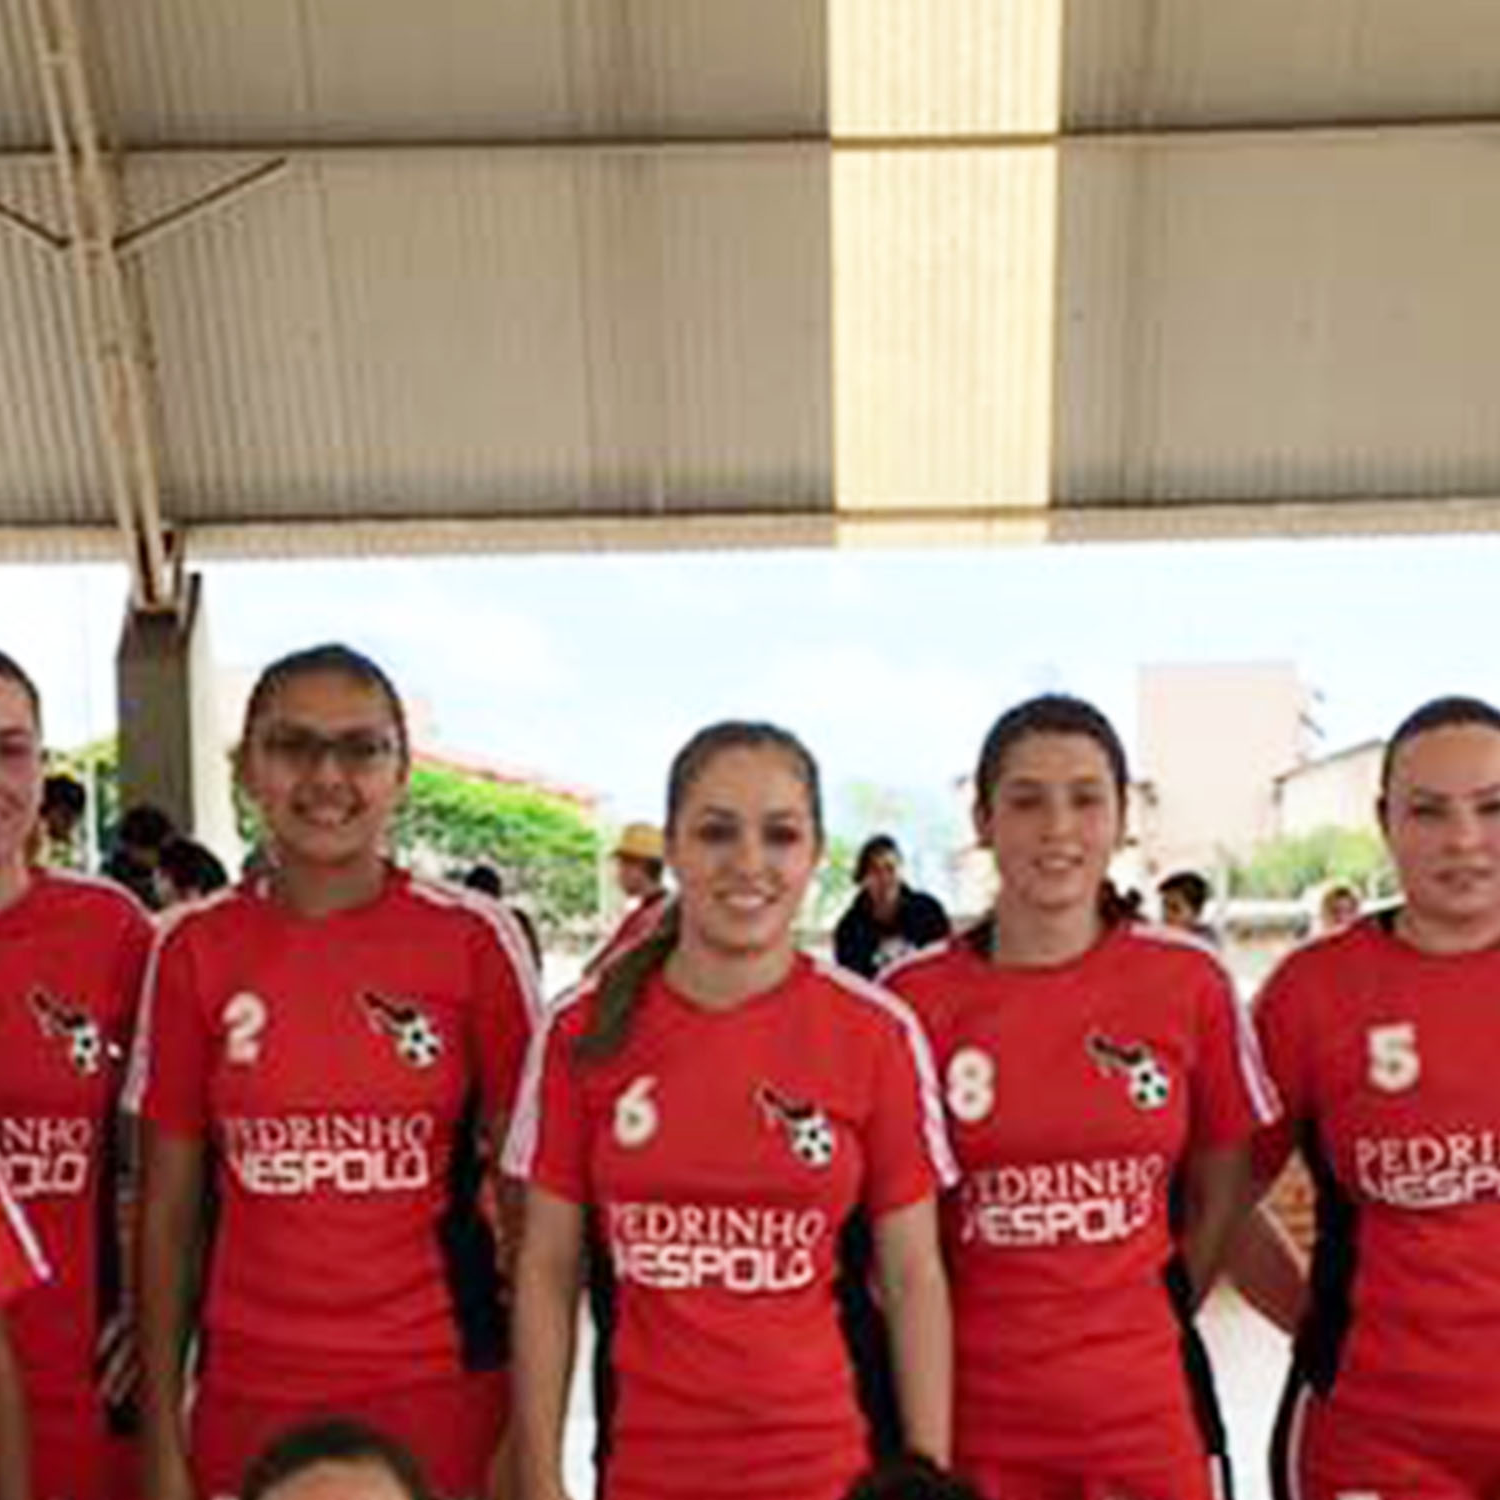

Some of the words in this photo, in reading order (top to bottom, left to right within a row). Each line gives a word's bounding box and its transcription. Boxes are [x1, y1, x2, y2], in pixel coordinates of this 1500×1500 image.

[223, 992, 267, 1064] 2
[1370, 1023, 1419, 1093] 5
[614, 1075, 658, 1149] 6
[947, 1047, 996, 1122] 8
[226, 1110, 434, 1151] DRINHO
[970, 1154, 1165, 1203] DRINHO
[962, 1197, 1155, 1245] ESPOLO
